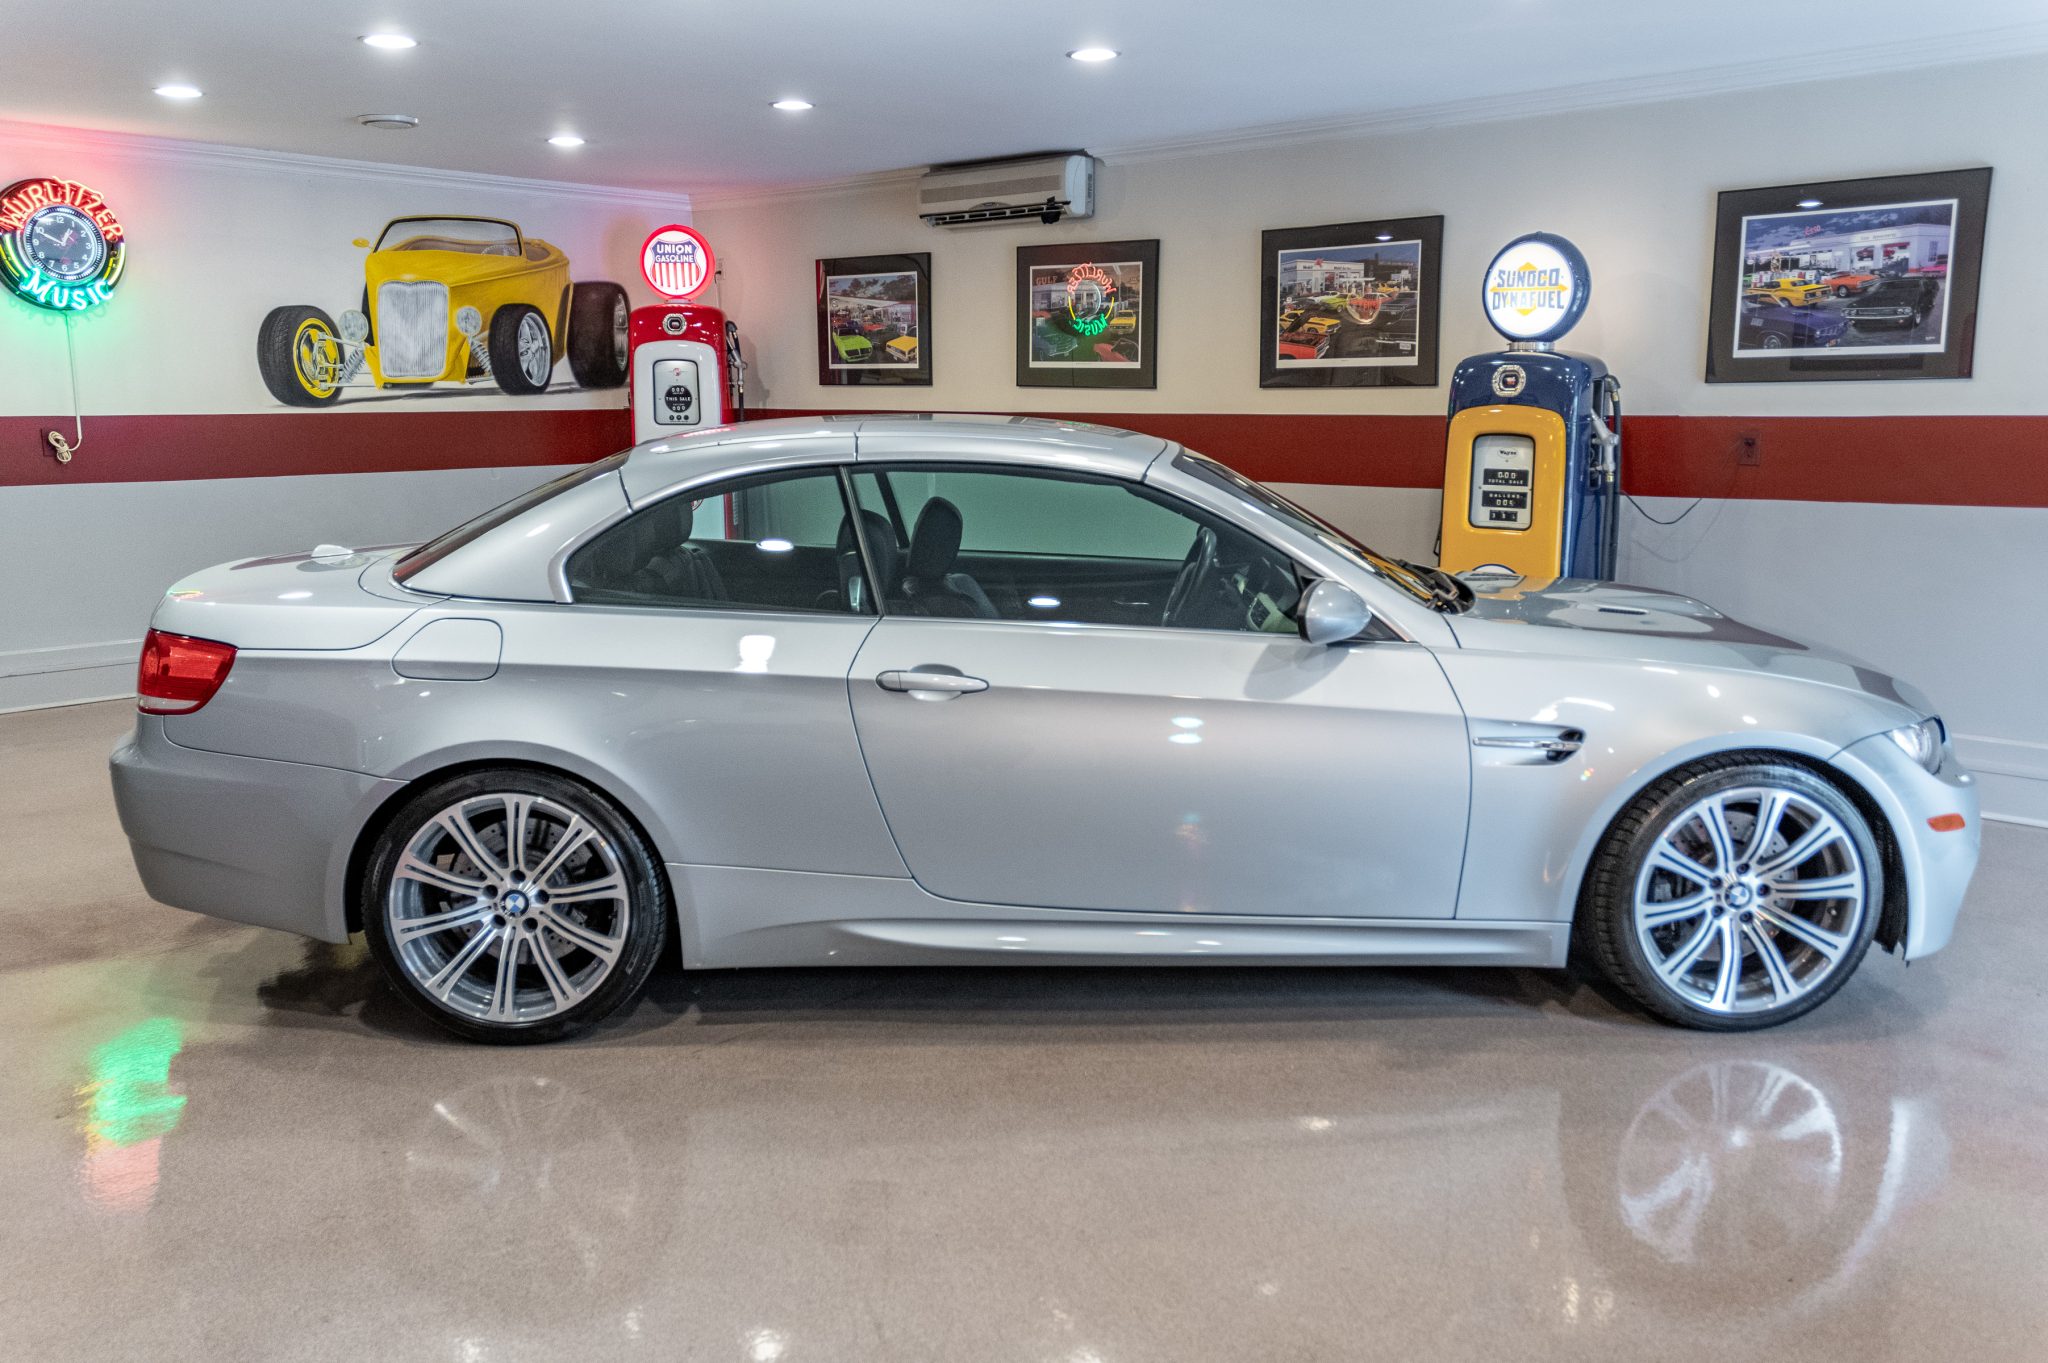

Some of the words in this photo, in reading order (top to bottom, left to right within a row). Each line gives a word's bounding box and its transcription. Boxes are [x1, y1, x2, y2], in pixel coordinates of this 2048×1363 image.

[0, 175, 124, 241] WURLITZER
[56, 216, 65, 224] 12
[656, 244, 693, 254] UNION
[39, 251, 45, 259] 8
[655, 254, 694, 263] GASOLINE
[1035, 275, 1058, 285] GULF
[1496, 268, 1561, 288] SUNOCO
[21, 266, 114, 310] MUSIC
[1492, 290, 1565, 310] DYNAFUEL
